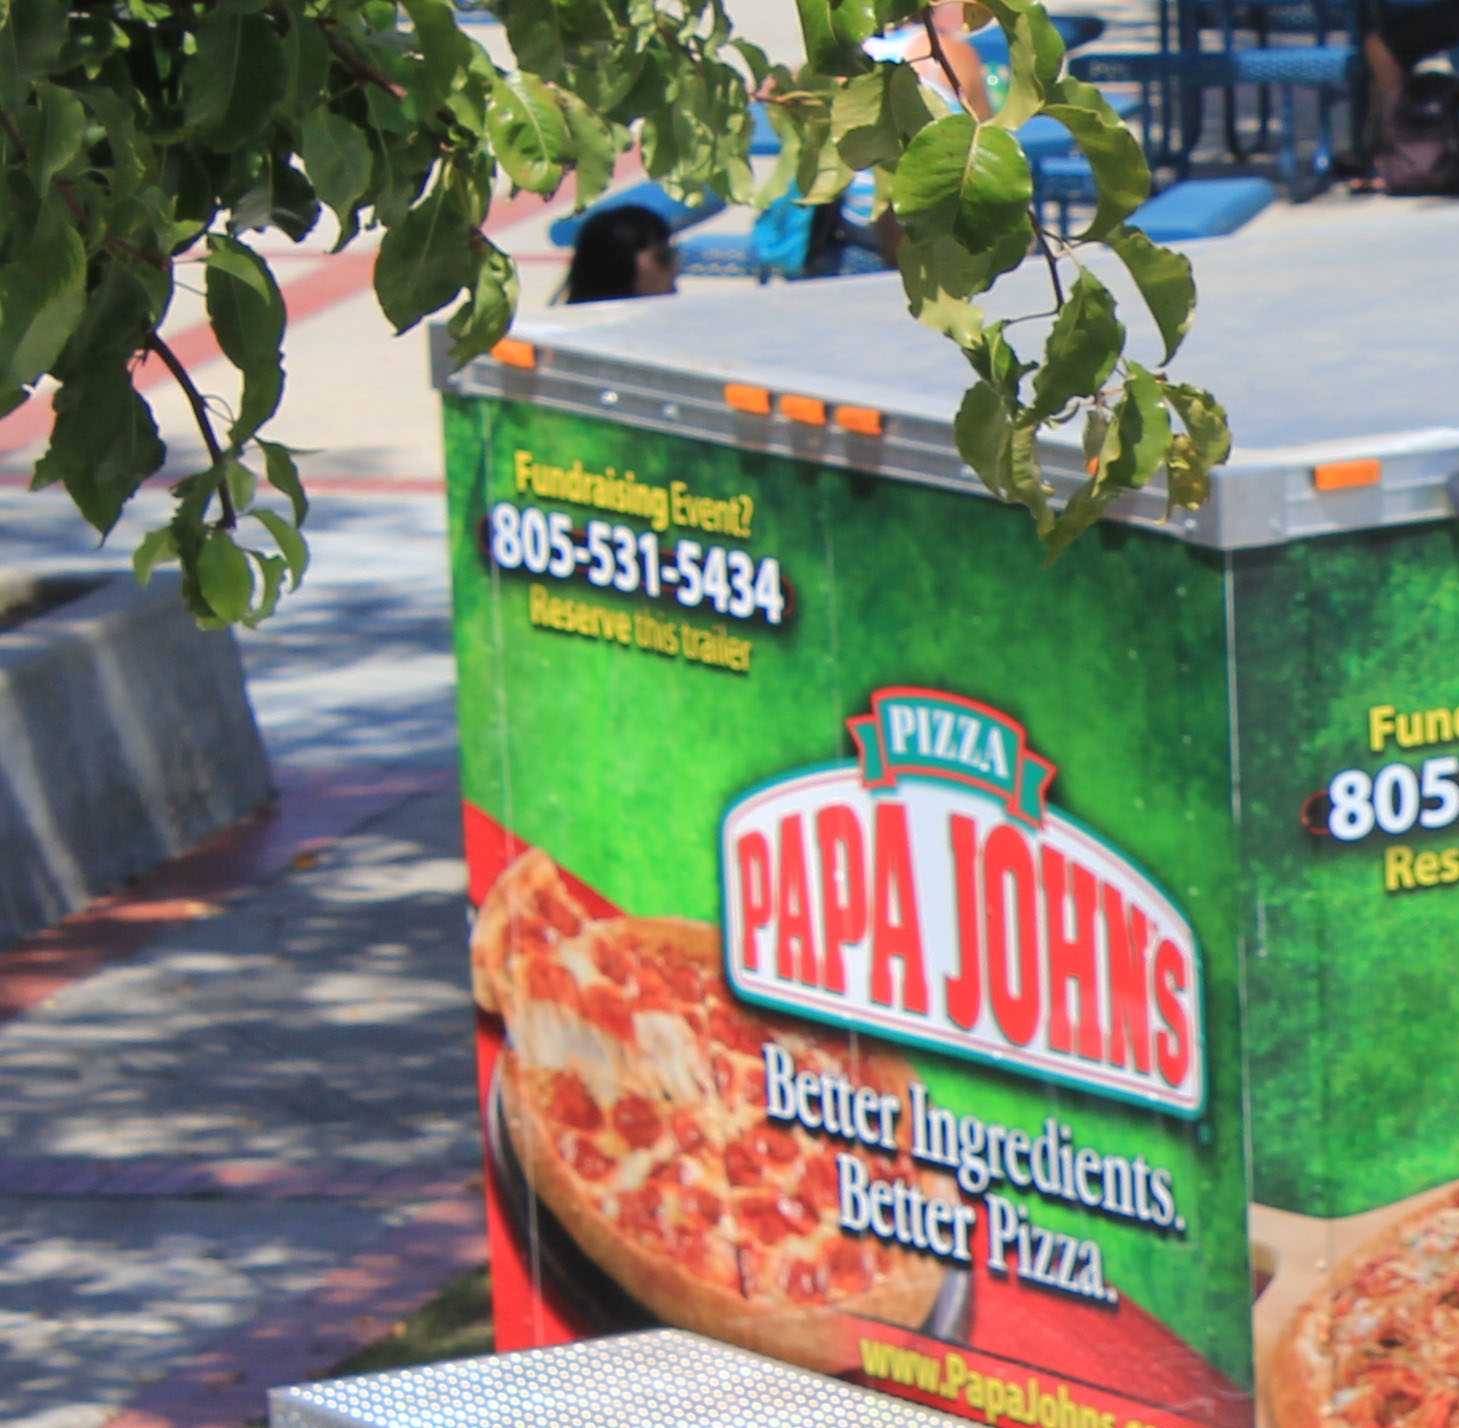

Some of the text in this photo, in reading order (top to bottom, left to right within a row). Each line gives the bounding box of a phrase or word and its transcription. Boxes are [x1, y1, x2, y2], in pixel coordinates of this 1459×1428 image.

[514, 450, 754, 538] Fundraising Event?
[491, 503, 785, 624] 805-531-5434
[530, 586, 752, 671] Reserve this trailer
[888, 703, 1009, 779] PIZZA
[737, 803, 930, 1016] PAPA
[764, 1044, 1187, 1231] Better Ingredients.
[836, 1153, 1120, 1304] Better Pizza.
